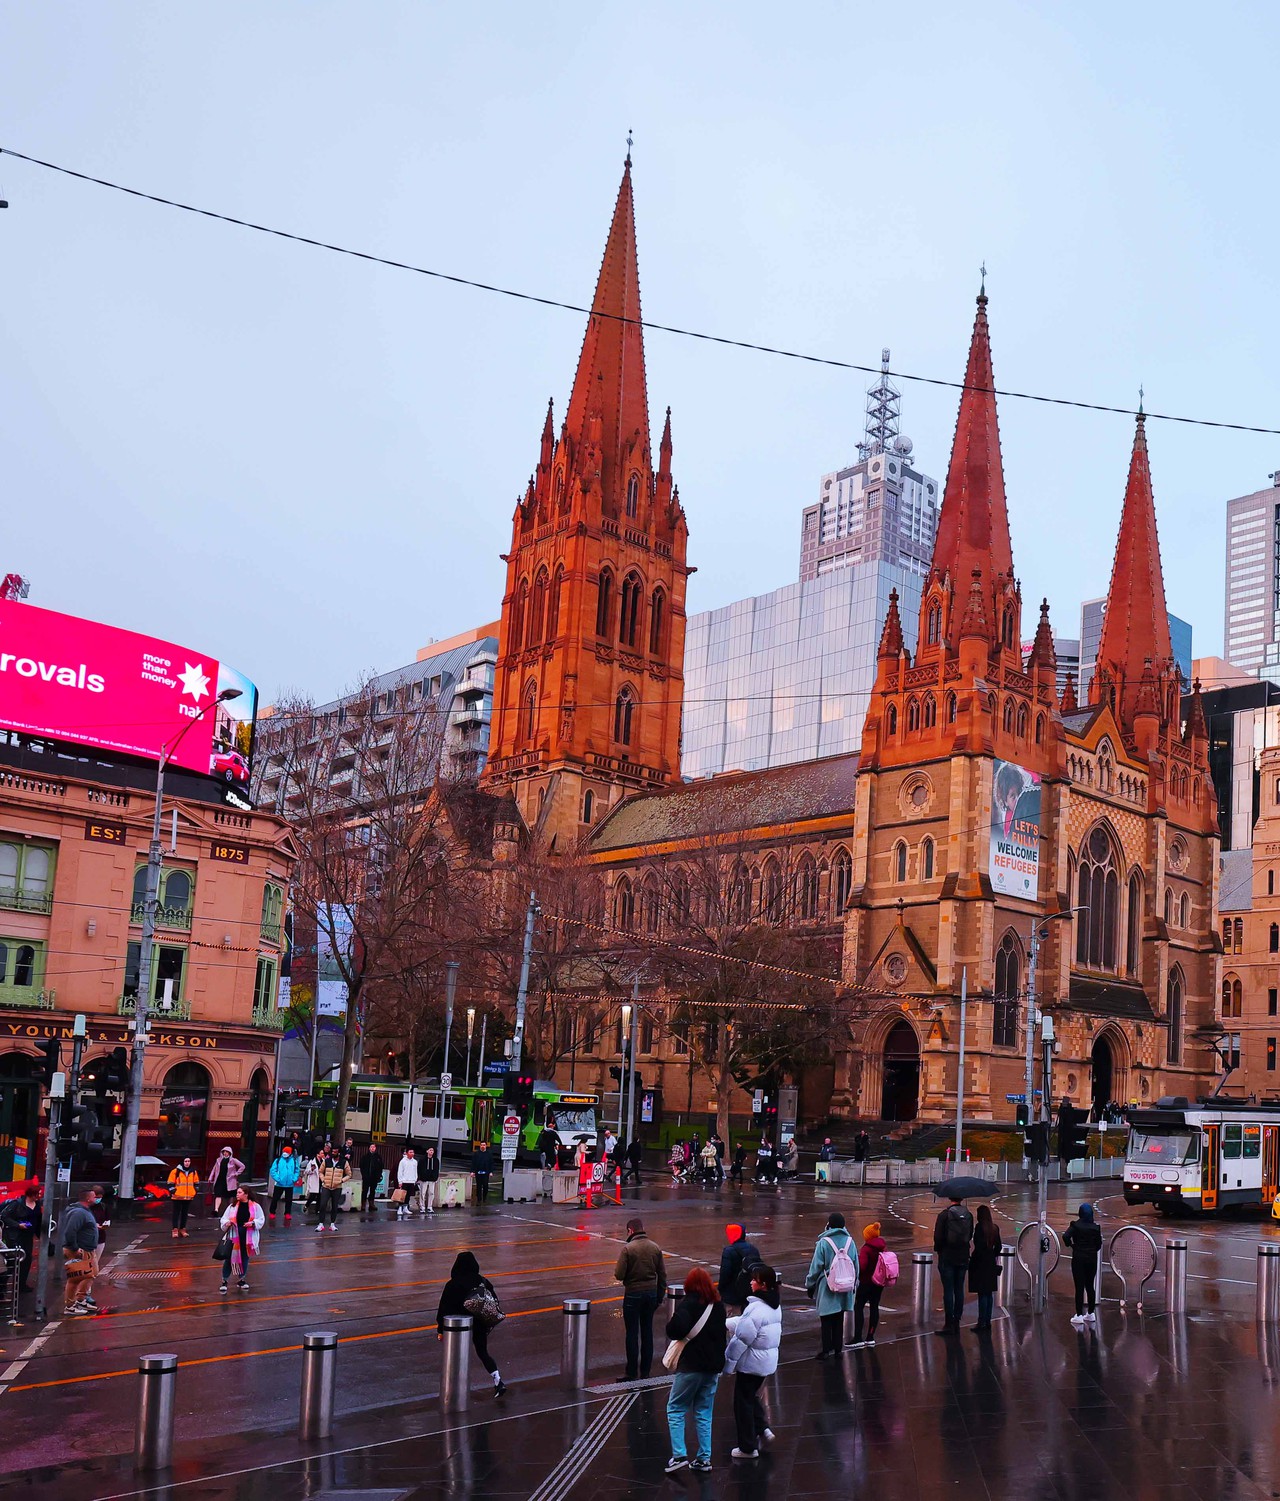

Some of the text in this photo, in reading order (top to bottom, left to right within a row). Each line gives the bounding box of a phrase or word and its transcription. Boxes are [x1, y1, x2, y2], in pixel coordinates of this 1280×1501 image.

[143, 653, 171, 667] more
[142, 661, 168, 676] than
[141, 671, 177, 689] money
[179, 703, 204, 721] nab
[1014, 819, 1039, 836] LET'S
[1011, 832, 1039, 848] FULLY
[215, 846, 244, 861] 1875
[997, 841, 1037, 862] WELCOME
[994, 854, 1037, 876] REFUGEES
[99, 1032, 108, 1041] &
[118, 1032, 217, 1048] JCKSON
